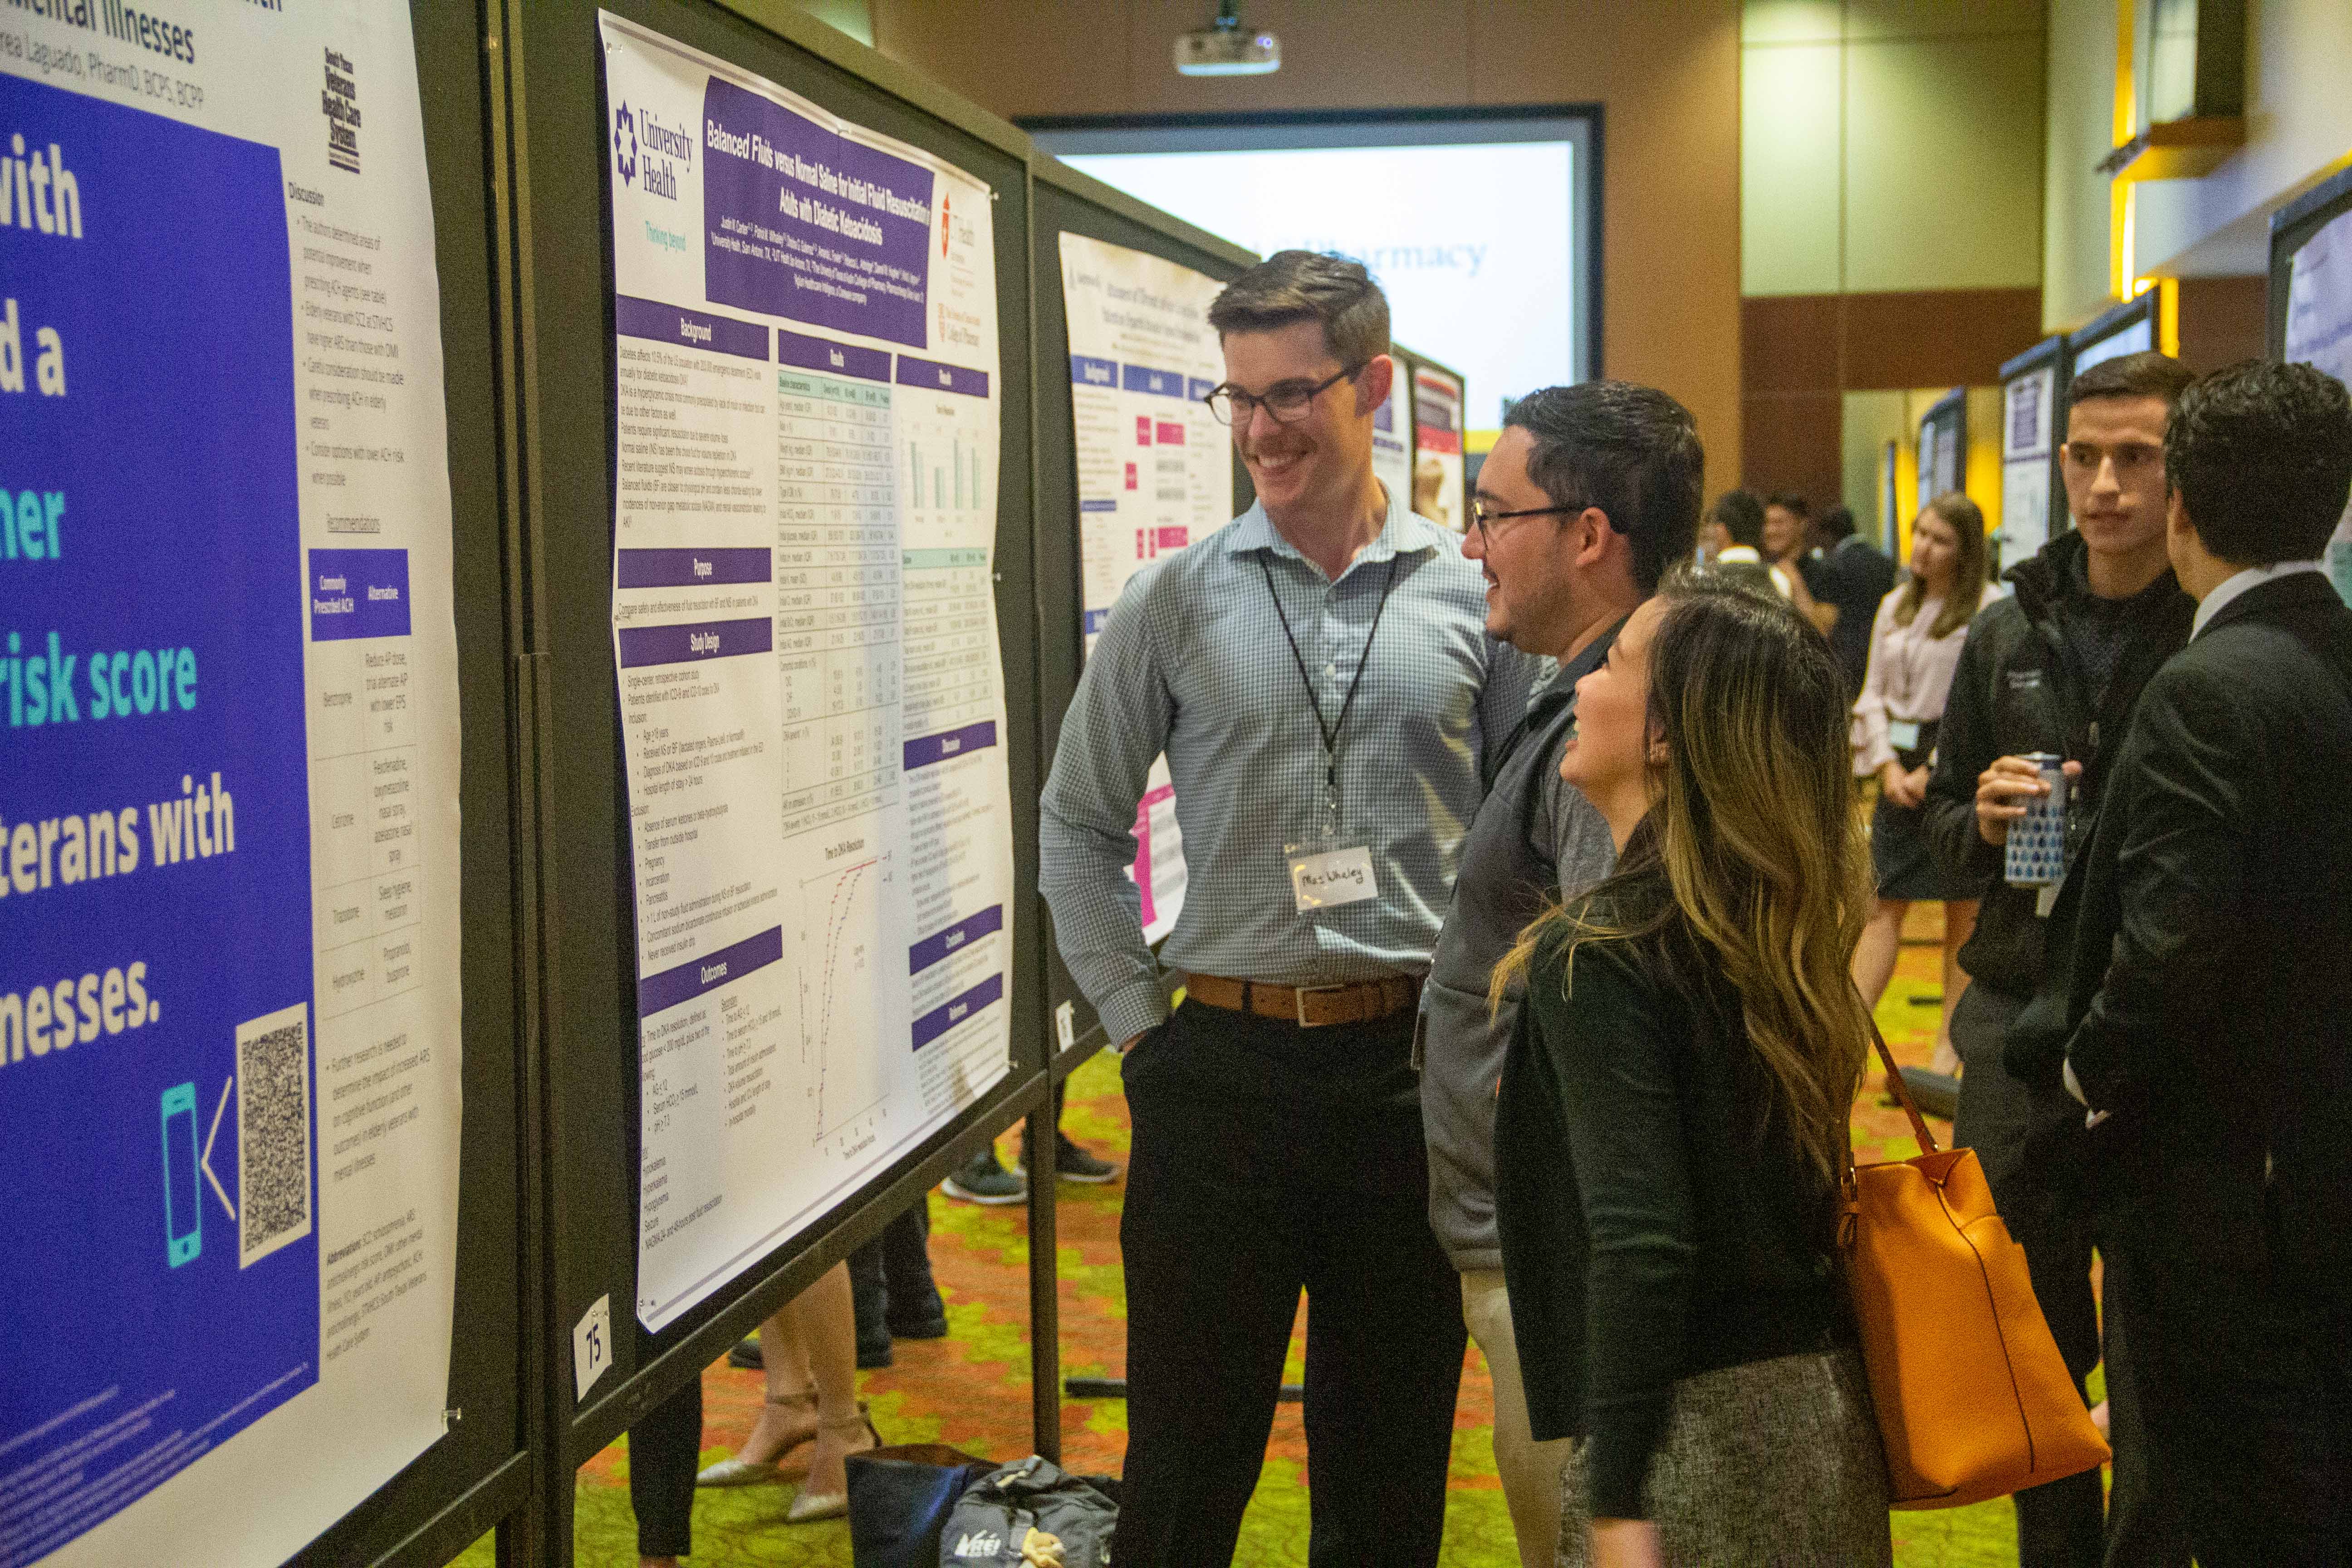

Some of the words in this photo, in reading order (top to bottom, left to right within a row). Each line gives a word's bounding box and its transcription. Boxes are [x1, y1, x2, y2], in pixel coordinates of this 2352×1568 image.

[640, 108, 693, 173] University
[707, 118, 750, 160] Balanced
[774, 150, 794, 177] versus
[795, 154, 818, 186] Normal
[819, 164, 838, 195] Saline
[867, 182, 886, 211] Fluid
[288, 181, 324, 206] Discussion
[643, 160, 677, 201] Health
[779, 186, 799, 219] Adults
[814, 200, 840, 233] Diabetic
[645, 220, 668, 249] Thinking
[681, 317, 711, 343] Background
[694, 558, 712, 580] Purpose
[367, 584, 399, 602] Alternative
[690, 632, 705, 655] Study
[705, 631, 720, 654] Design
[90, 646, 197, 720] score
[148, 771, 235, 867] with
[701, 961, 727, 985] Outcomes
